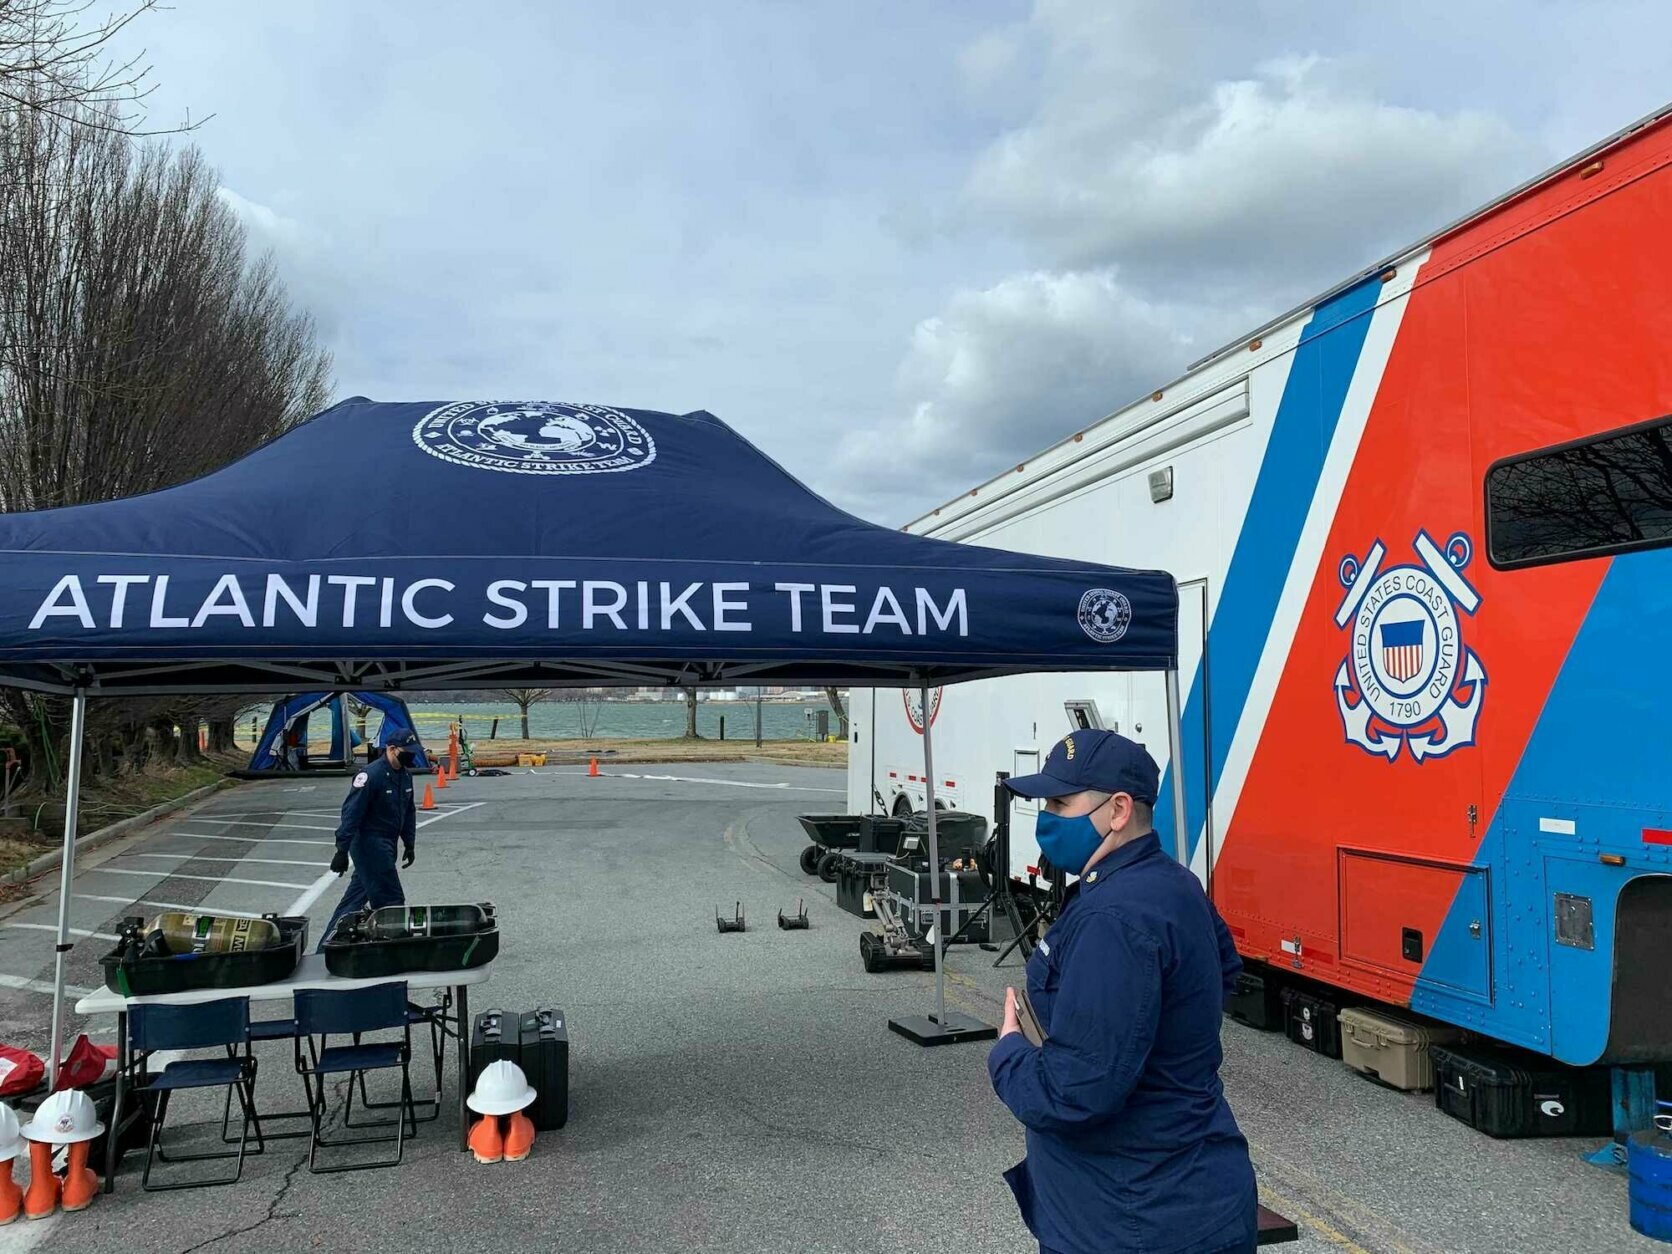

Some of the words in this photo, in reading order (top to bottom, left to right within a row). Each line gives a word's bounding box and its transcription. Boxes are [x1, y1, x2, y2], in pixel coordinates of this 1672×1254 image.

[434, 443, 519, 468] ATLANTIC
[520, 461, 595, 471] STRIKE
[28, 573, 455, 630] ATLANTIC
[482, 579, 753, 631] STRIKE
[775, 582, 969, 637] TEAM
[1360, 575, 1401, 628] STATES
[1405, 574, 1449, 619] COAST
[1357, 633, 1381, 702] UNITED
[1429, 626, 1454, 699] GUARD
[1389, 700, 1422, 718] 1790
